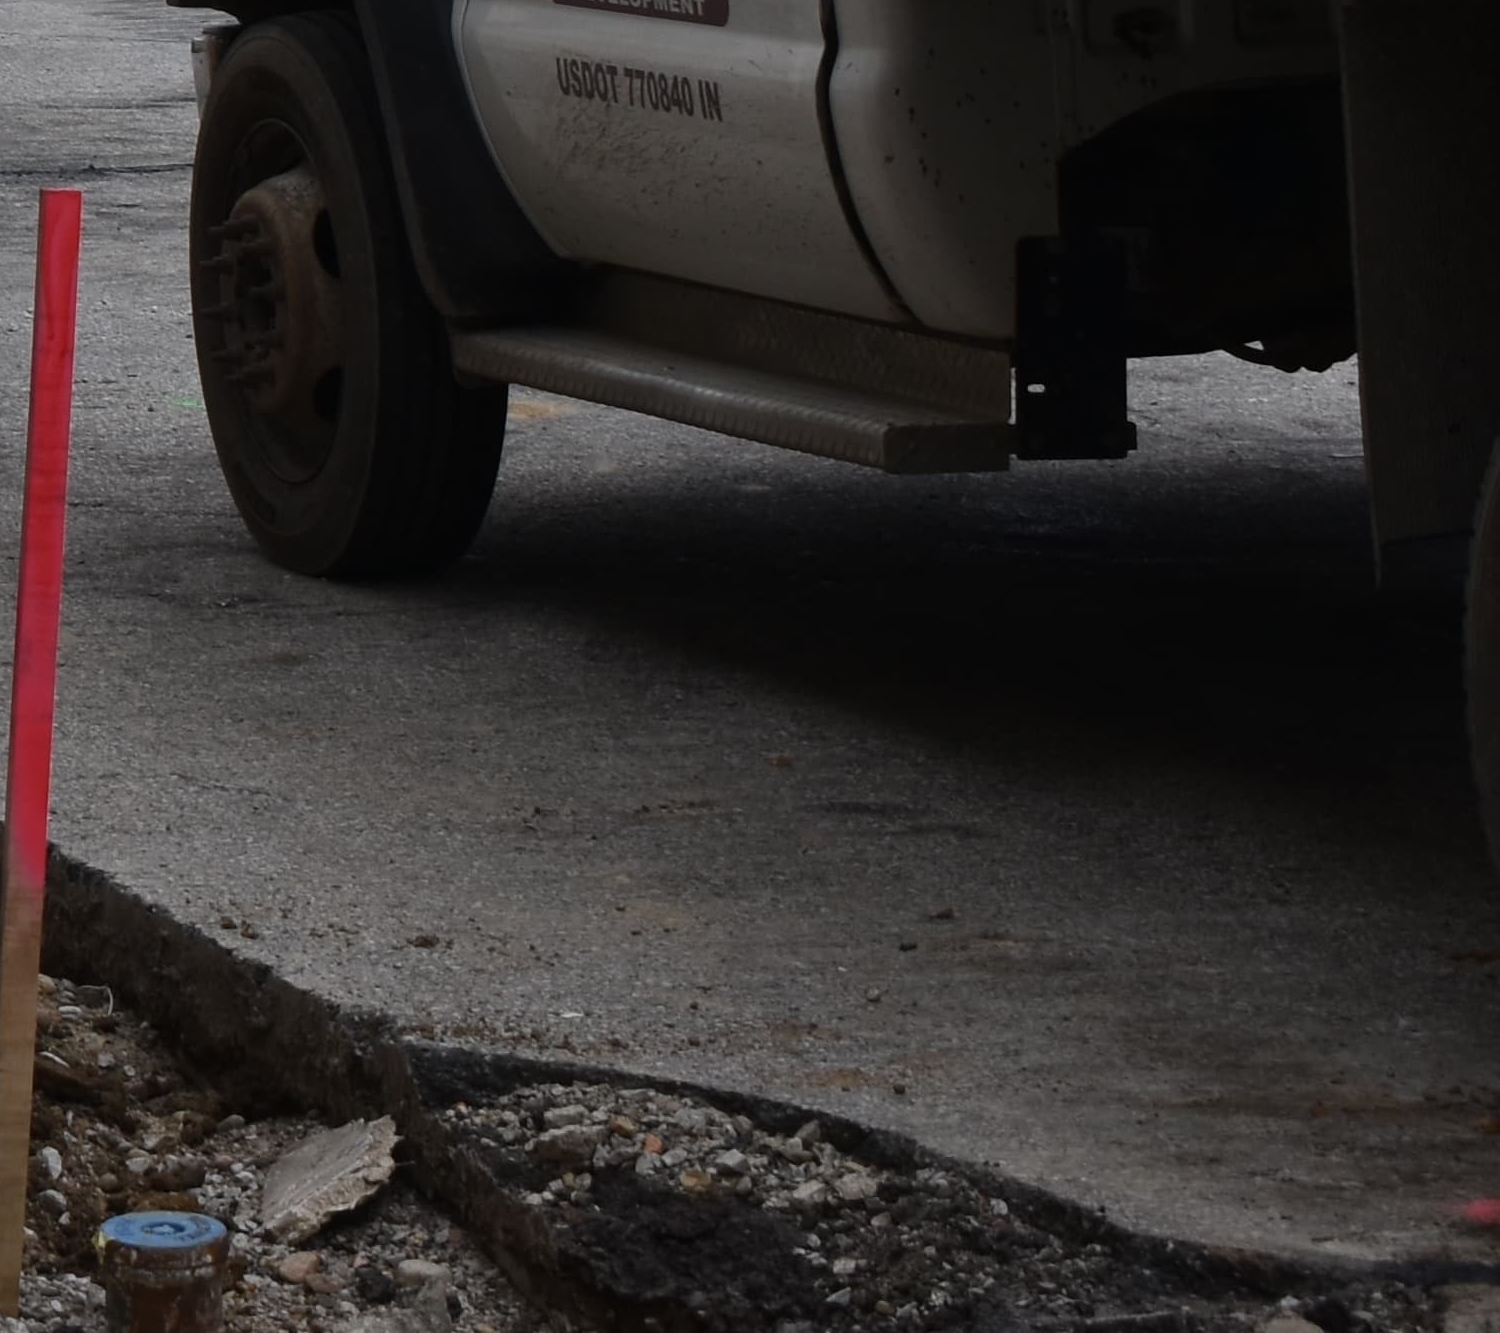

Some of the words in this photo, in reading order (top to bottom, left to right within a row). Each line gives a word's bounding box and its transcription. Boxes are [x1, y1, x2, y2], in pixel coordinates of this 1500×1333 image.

[556, 57, 618, 103] USDOT
[623, 69, 694, 118] 770840
[698, 80, 724, 122] IN
